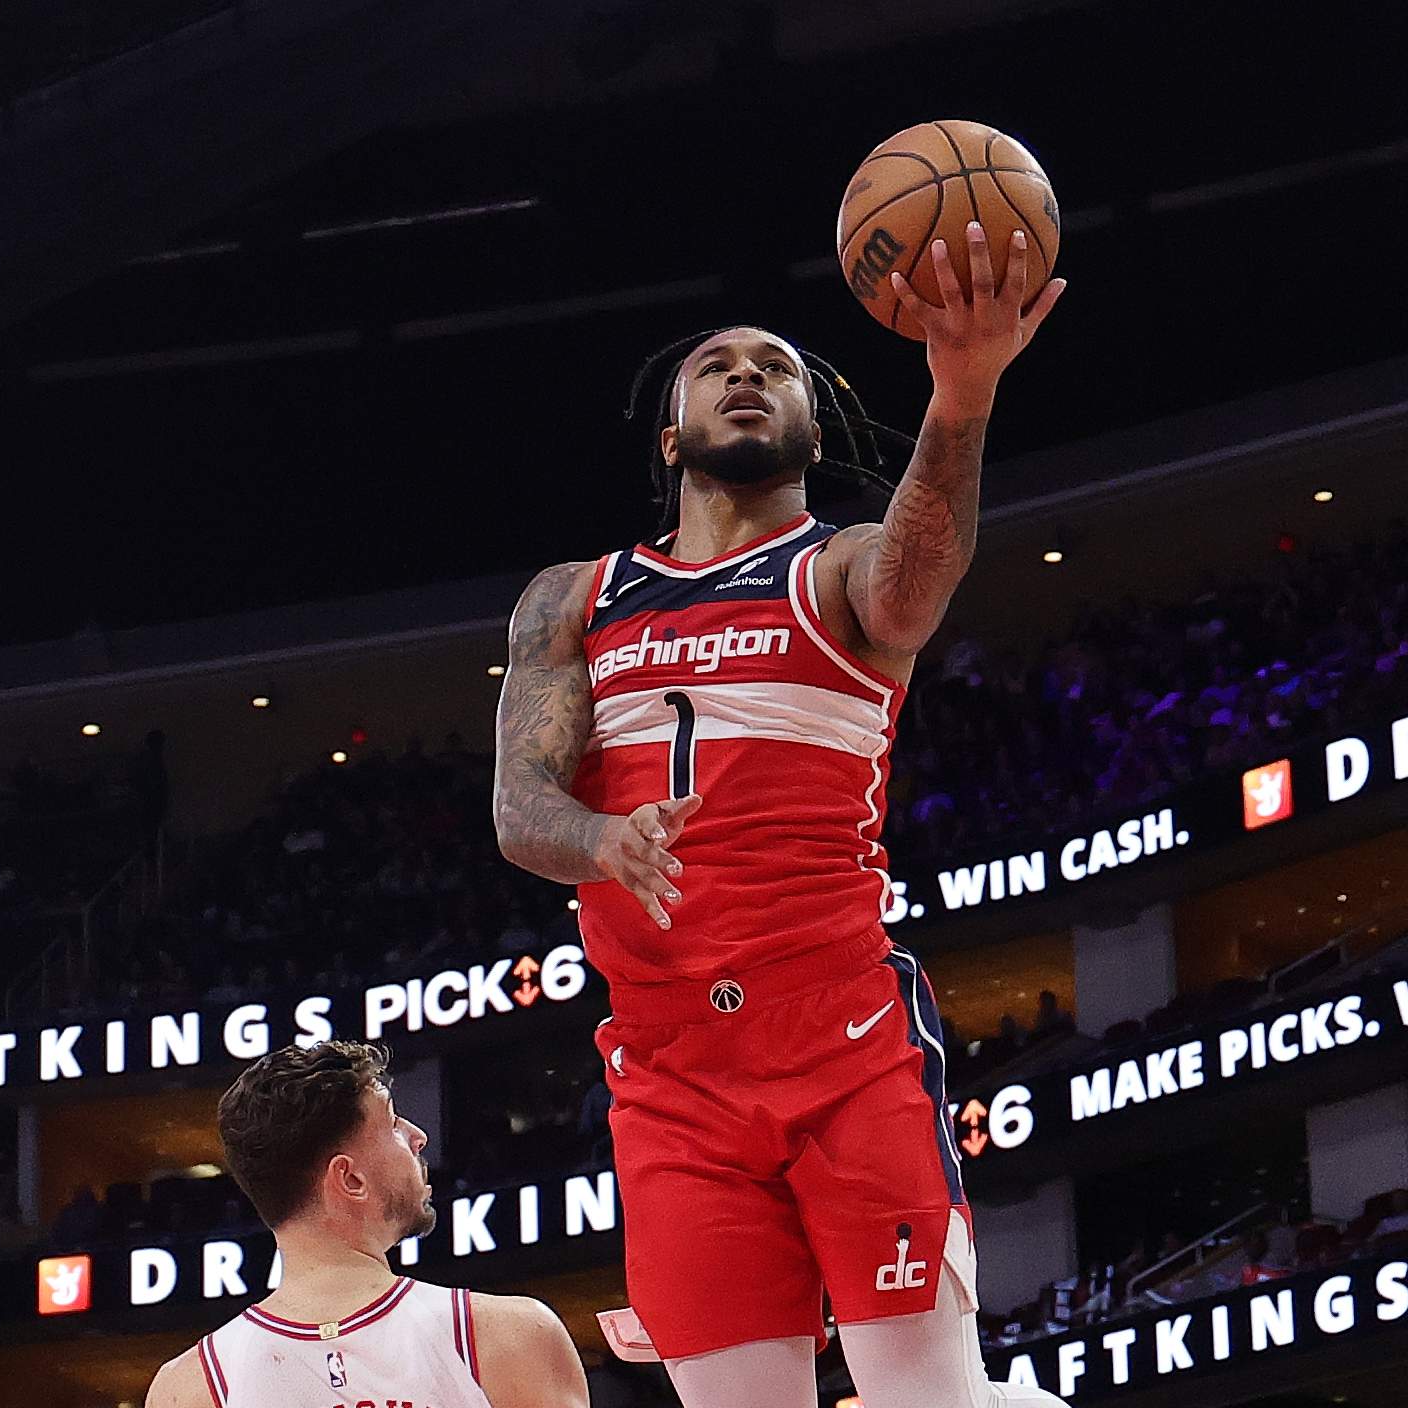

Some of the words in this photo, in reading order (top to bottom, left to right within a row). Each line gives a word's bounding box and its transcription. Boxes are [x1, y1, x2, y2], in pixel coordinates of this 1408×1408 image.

[715, 576, 774, 591] Robinhood
[664, 690, 696, 800] 1
[938, 843, 1045, 910] WIN
[1061, 808, 1190, 881] CASH.
[1071, 1042, 1204, 1121] MAKE
[1220, 996, 1380, 1078] PICKS.
